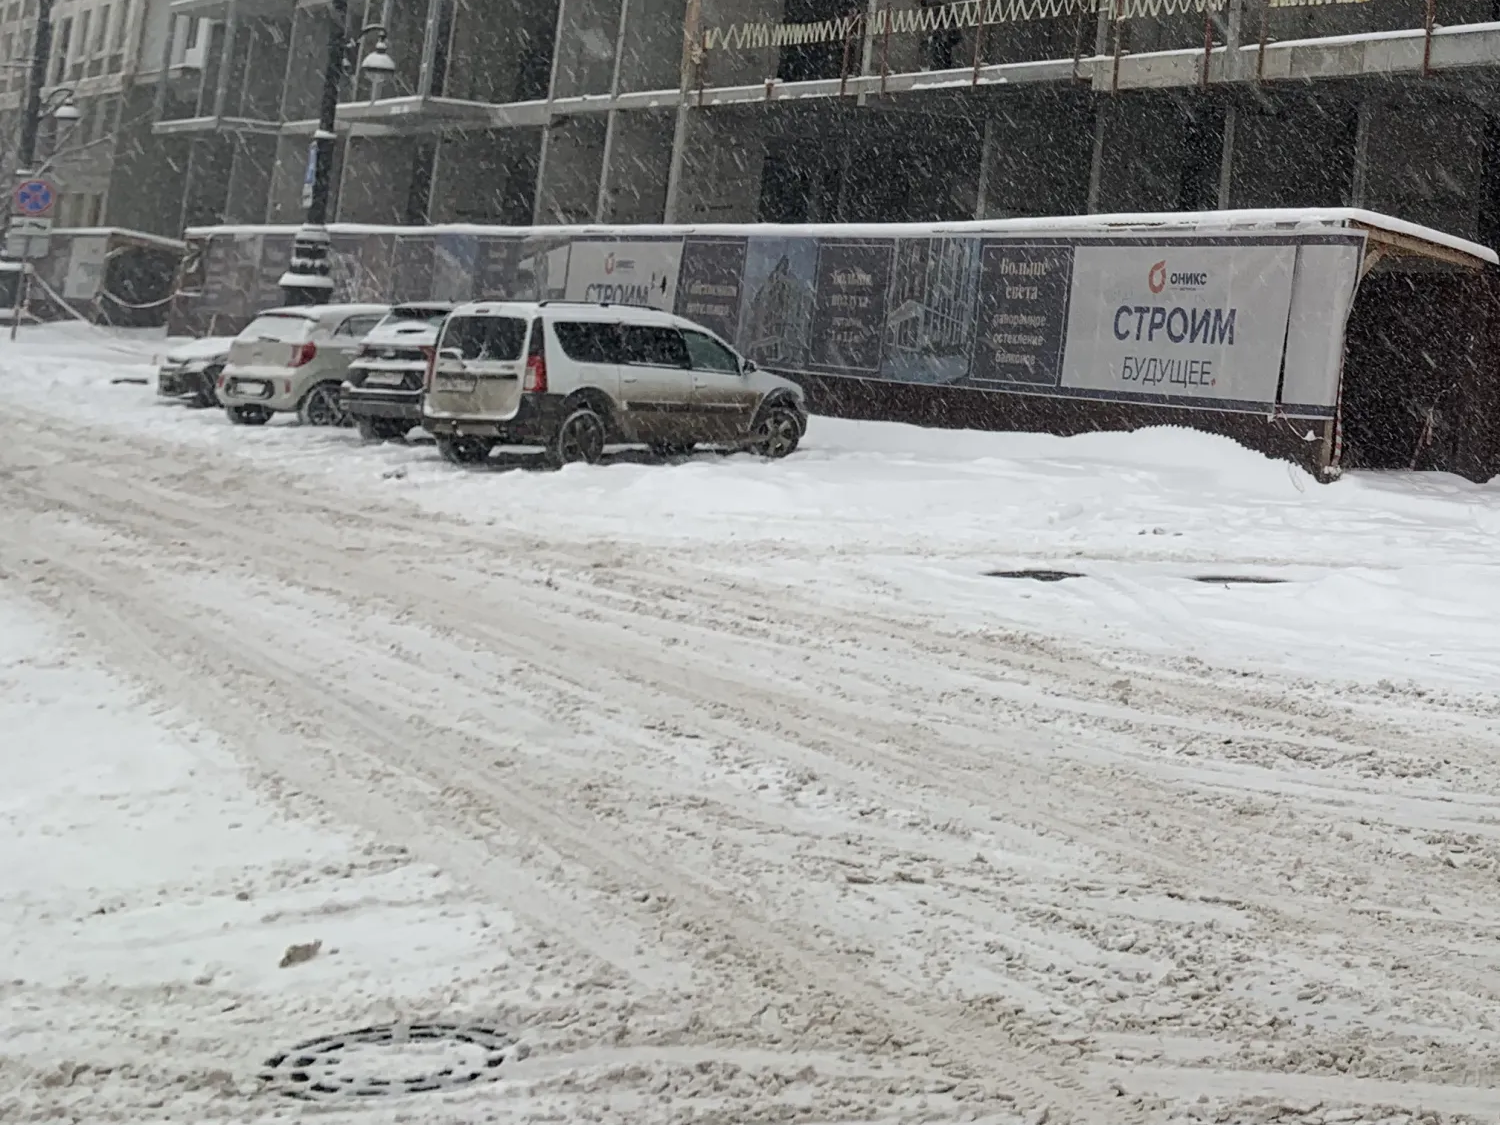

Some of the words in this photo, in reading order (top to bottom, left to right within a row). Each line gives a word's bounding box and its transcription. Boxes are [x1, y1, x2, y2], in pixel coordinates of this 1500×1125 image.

[1170, 273, 1208, 286] ОНИКС
[1005, 284, 1038, 300] света
[1113, 305, 1237, 345] СТРОИМ
[1122, 356, 1216, 388] БУДУЩЕЕ.
